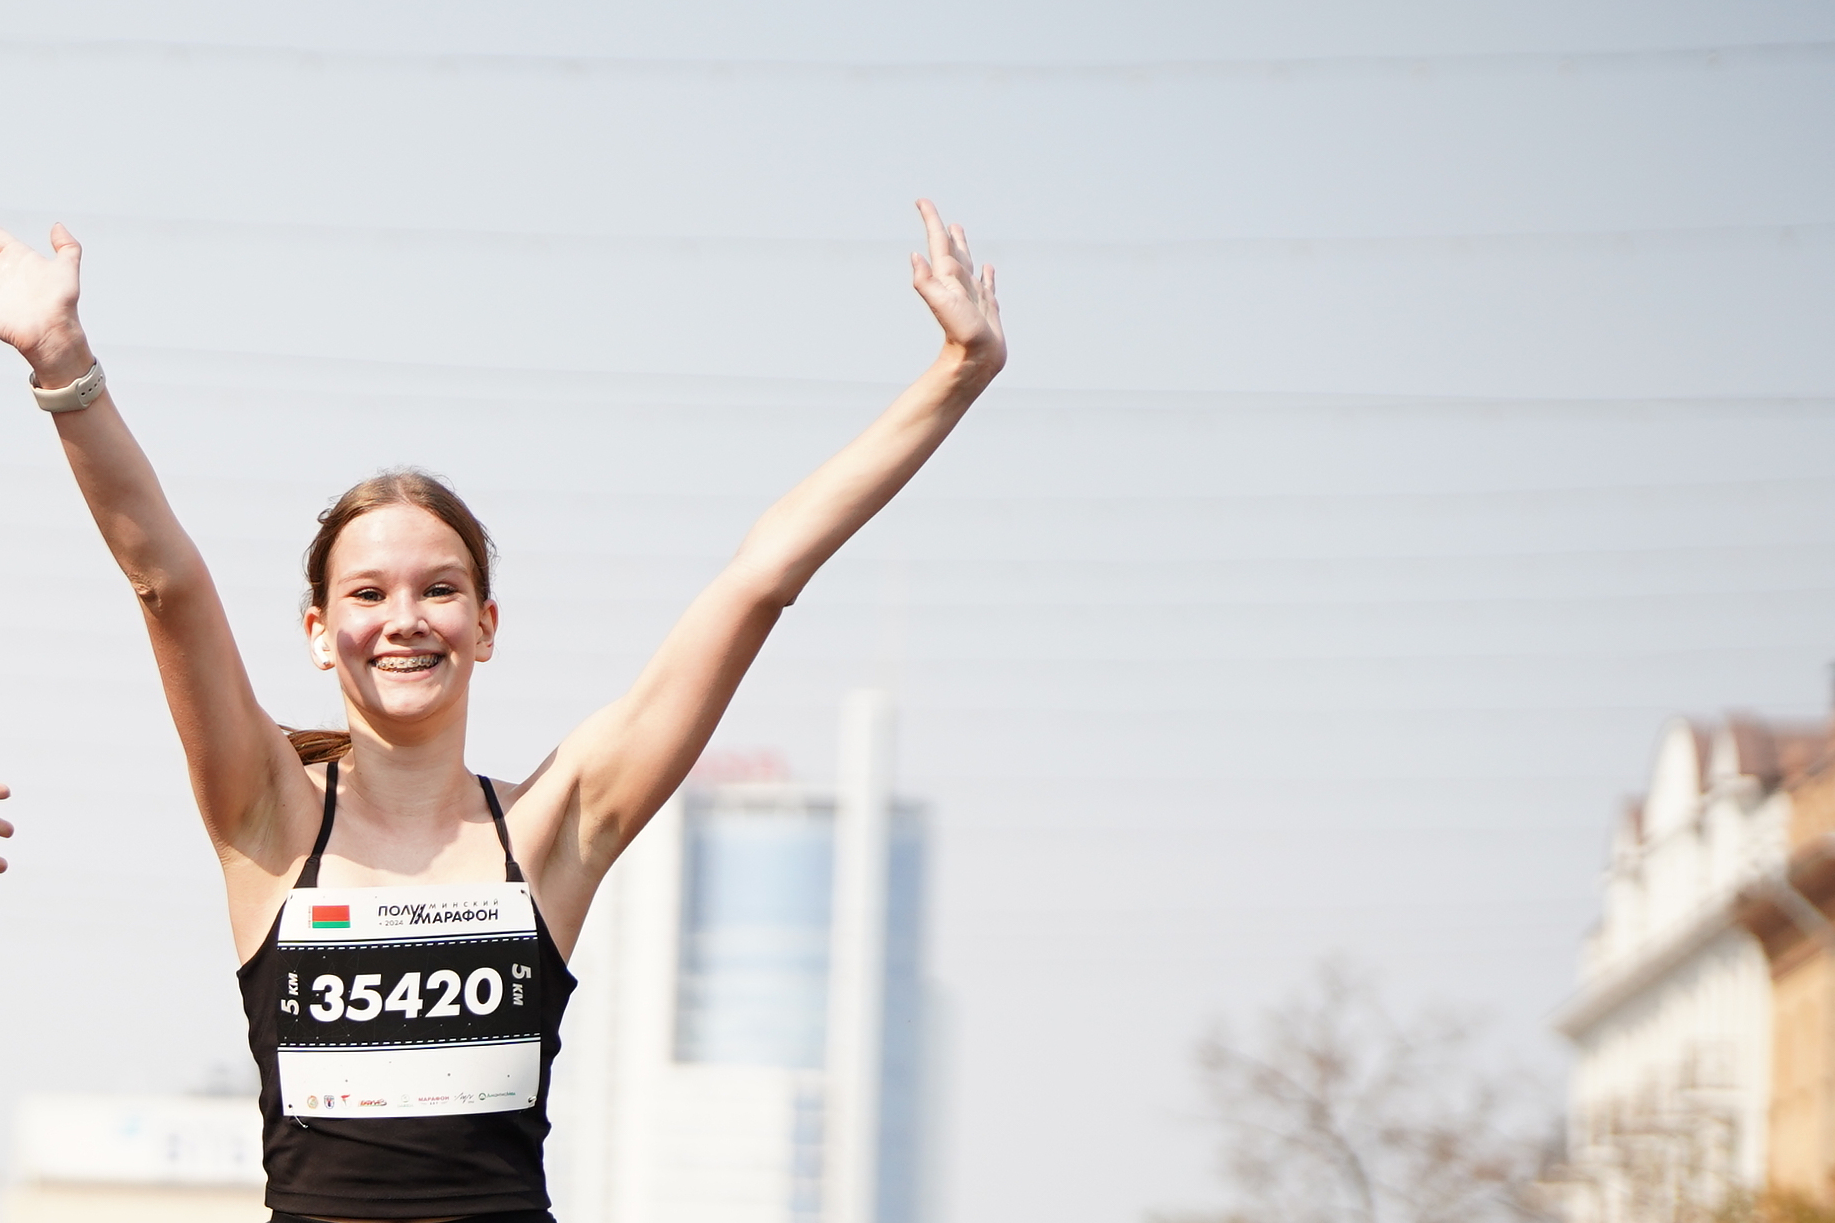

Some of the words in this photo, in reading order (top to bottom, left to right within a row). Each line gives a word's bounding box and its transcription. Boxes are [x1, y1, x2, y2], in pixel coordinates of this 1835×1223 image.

[429, 899, 498, 909] МИНСКИЙ
[511, 963, 532, 980] 5
[309, 967, 504, 1022] 35420
[281, 999, 300, 1016] 5
